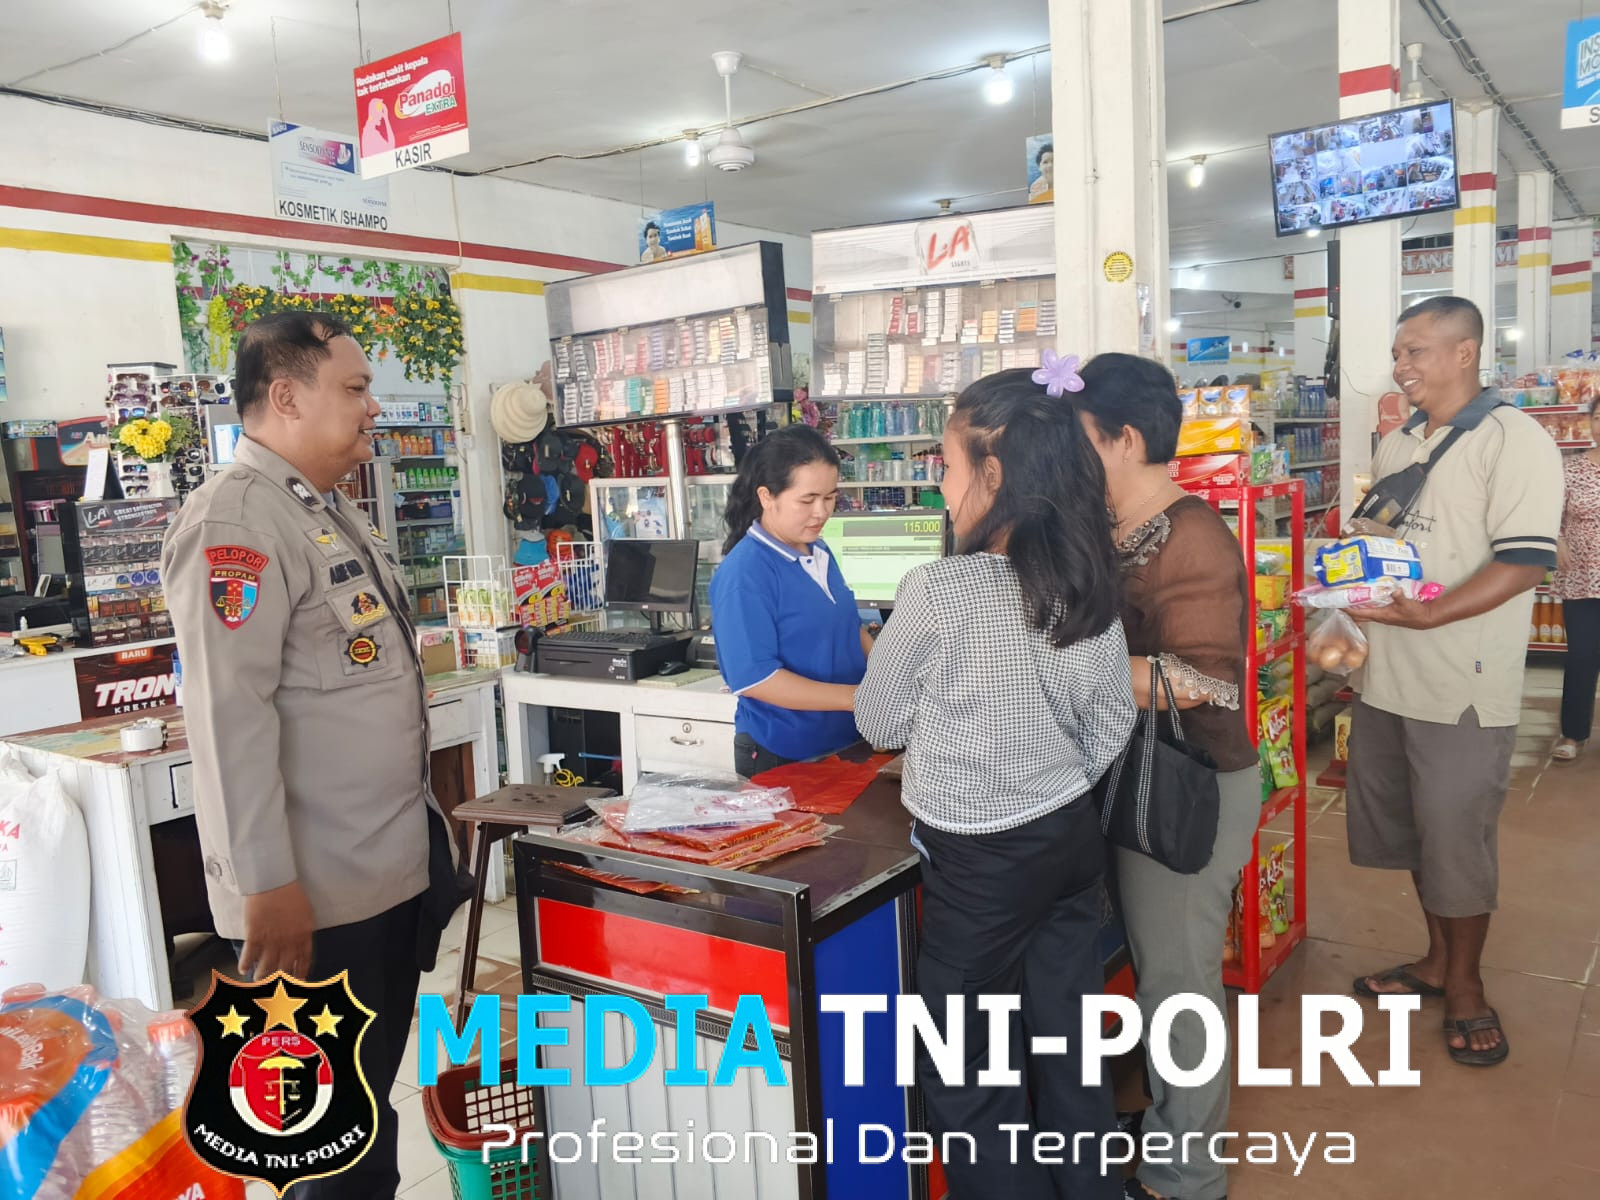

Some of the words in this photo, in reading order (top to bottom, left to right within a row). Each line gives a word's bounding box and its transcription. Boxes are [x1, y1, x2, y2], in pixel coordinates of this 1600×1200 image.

[386, 63, 404, 77] sakit
[405, 56, 429, 71] kepala
[357, 88, 368, 97] tak
[369, 73, 411, 93] tertahankan
[399, 76, 456, 108] Panadol
[425, 97, 457, 115] EXTRA
[299, 141, 336, 160] SENSODYNE
[395, 142, 432, 168] KASIR
[279, 200, 337, 223] KOSMETIK
[904, 521, 940, 533] 115.000
[210, 549, 263, 569] PELOPOR
[214, 569, 256, 581] PROPAM
[121, 649, 148, 660] BARU
[95, 673, 176, 708] TRON
[114, 699, 166, 714] KRETEK
